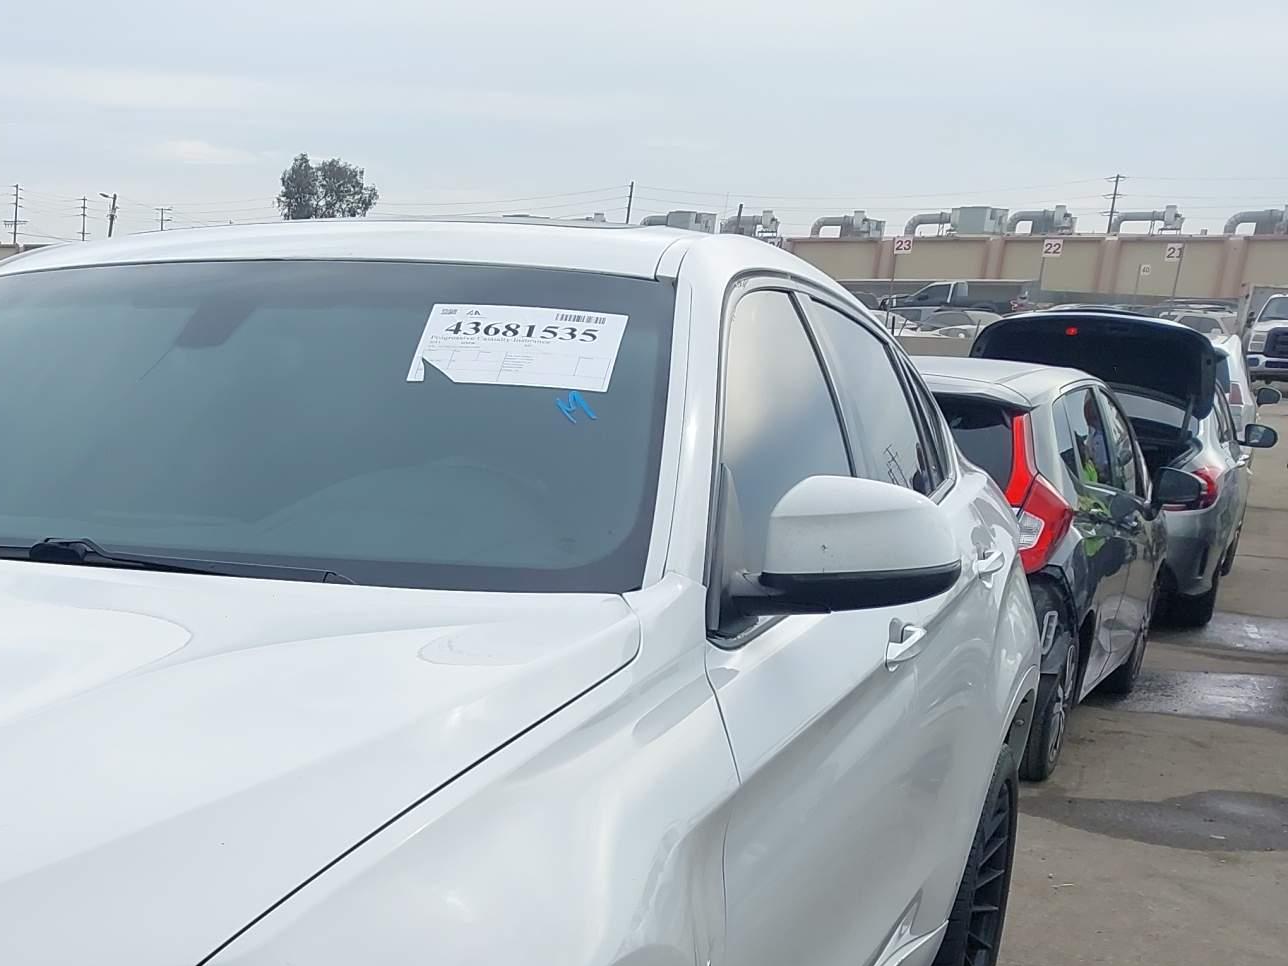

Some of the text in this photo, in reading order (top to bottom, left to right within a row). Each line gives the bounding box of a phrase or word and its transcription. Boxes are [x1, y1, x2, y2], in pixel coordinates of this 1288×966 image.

[895, 239, 912, 251] 23
[1044, 242, 1062, 255] 22
[1166, 247, 1183, 259] 21
[445, 320, 600, 343] 43681535
